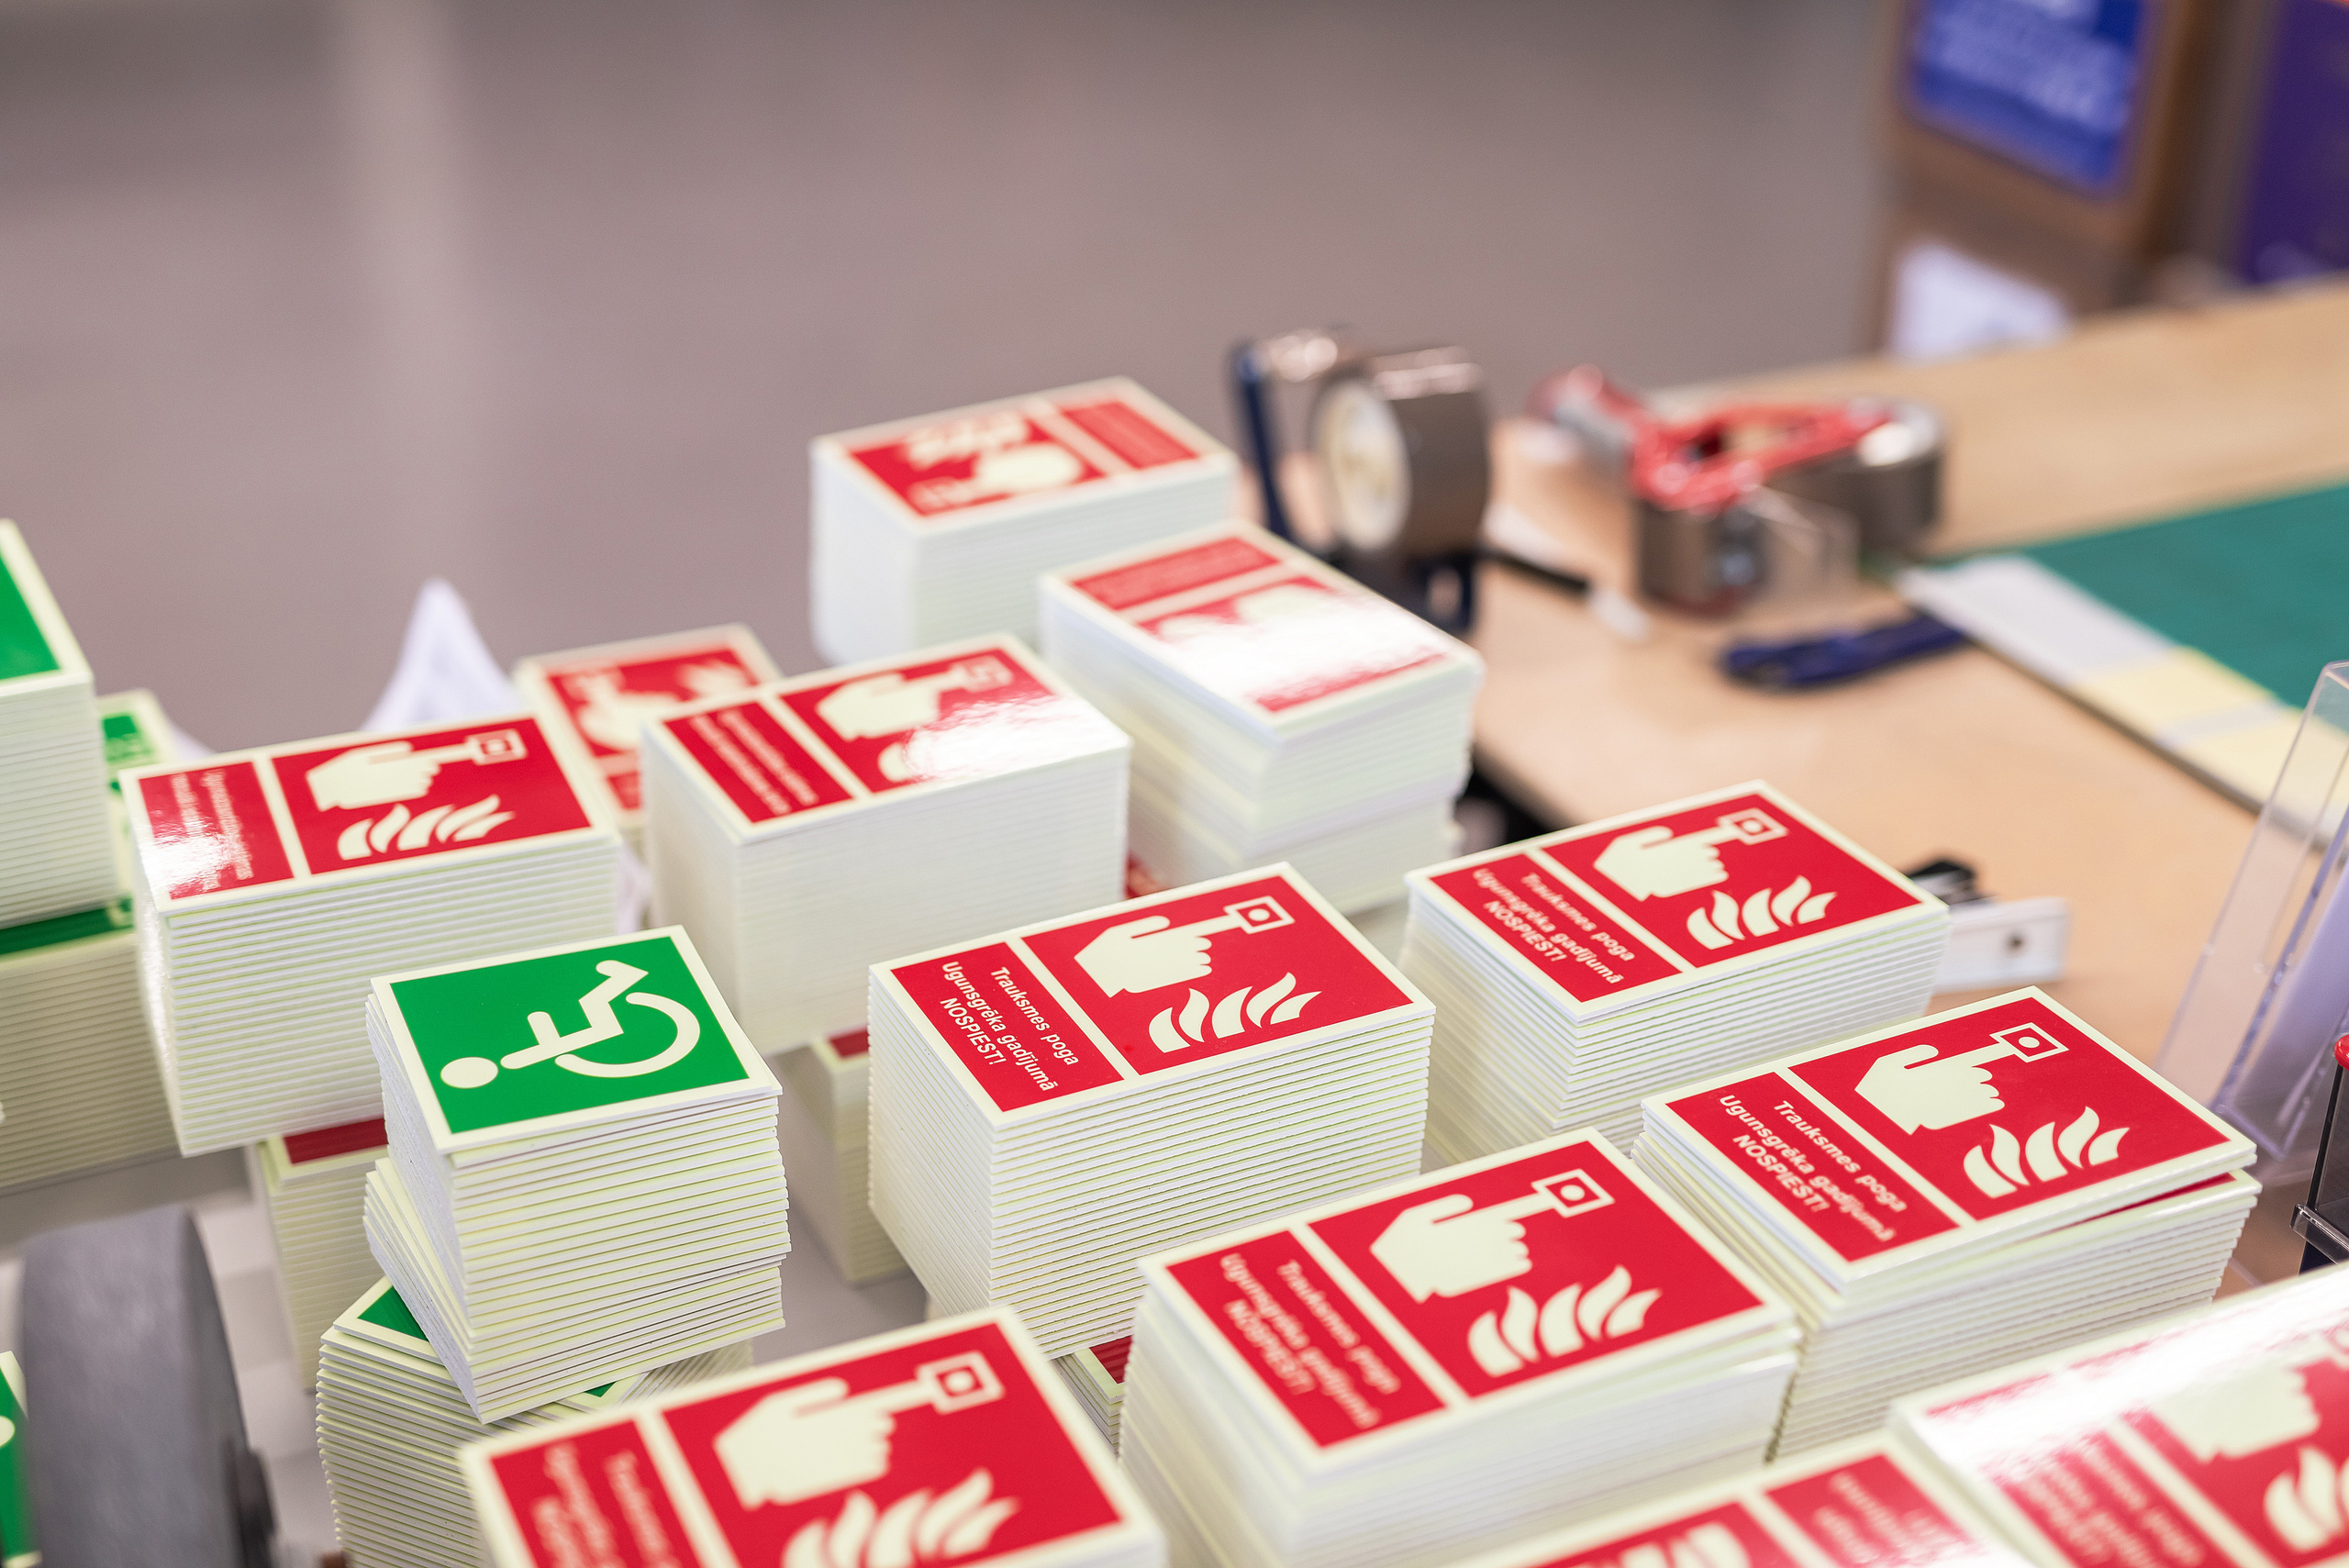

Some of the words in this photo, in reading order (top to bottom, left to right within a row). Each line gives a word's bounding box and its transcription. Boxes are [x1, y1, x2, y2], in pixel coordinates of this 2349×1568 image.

[1484, 900, 1567, 962] NOSPIEST!
[1521, 873, 1598, 931] Trauksmes
[1590, 931, 1635, 962] poga
[1550, 933, 1624, 984] gadījumā
[940, 997, 1007, 1065] NOSPIEST!
[941, 962, 1006, 1032] Ugunsgrēka
[996, 1034, 1058, 1091] gadījumā
[991, 966, 1050, 1031] Trauksmes
[1041, 1033, 1079, 1065] poga
[1720, 1095, 1815, 1174] Ugunsgrēka
[1774, 1101, 1861, 1173] Trauksmes
[1854, 1174, 1908, 1212] poga
